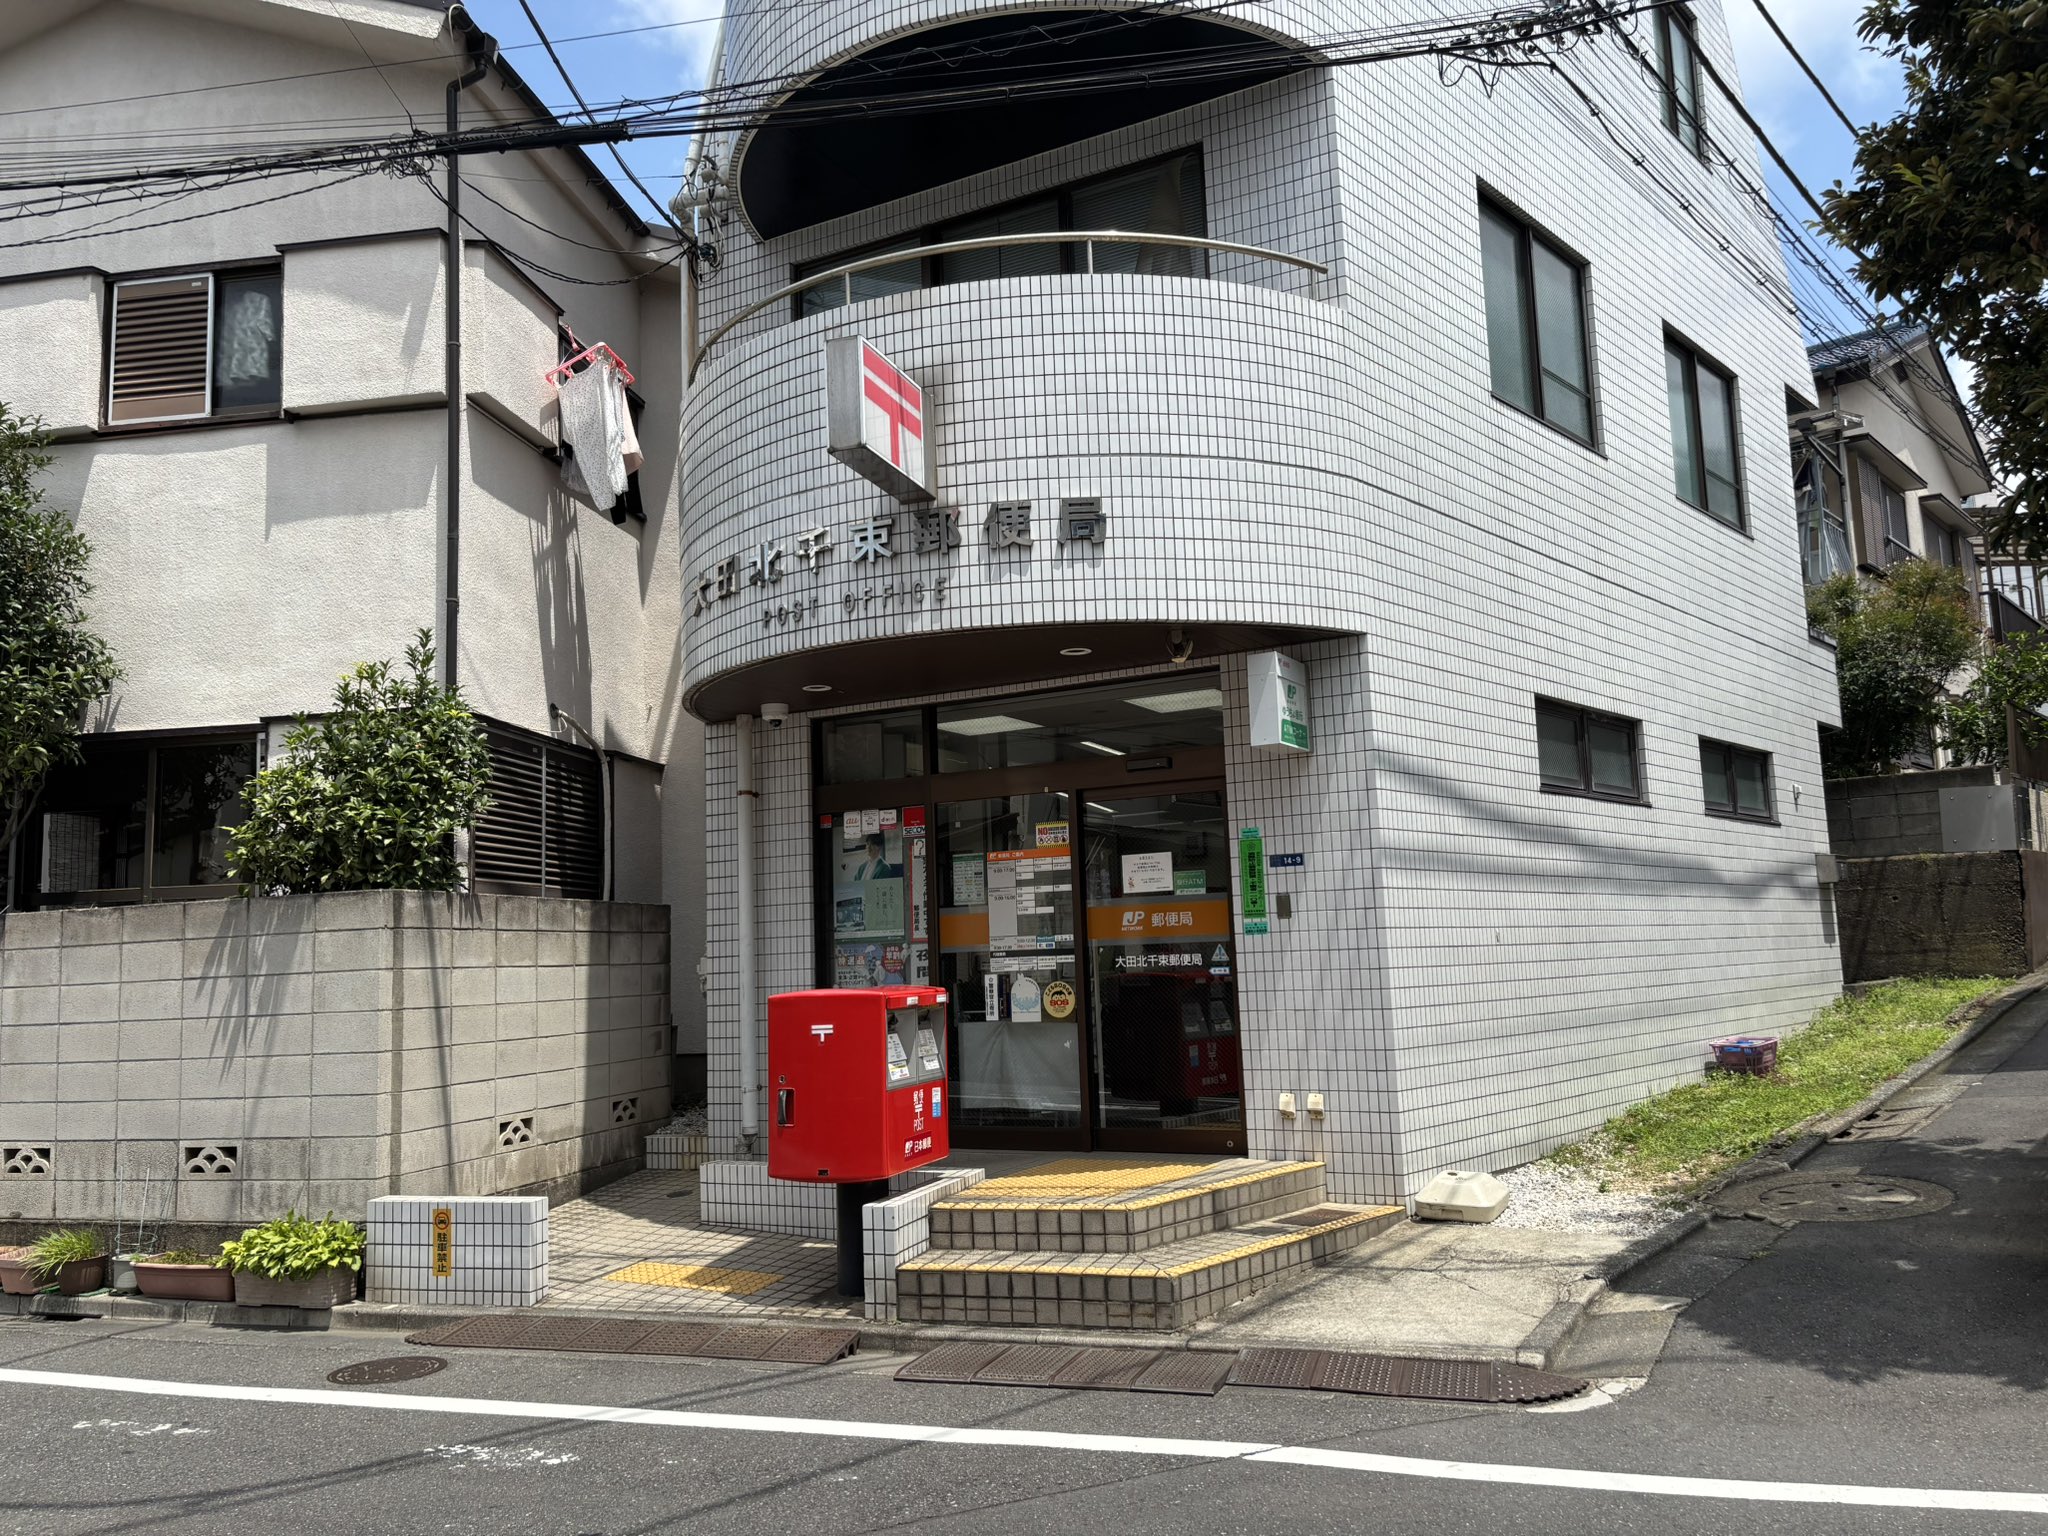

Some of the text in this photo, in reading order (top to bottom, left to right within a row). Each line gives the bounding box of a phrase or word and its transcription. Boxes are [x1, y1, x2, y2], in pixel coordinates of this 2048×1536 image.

[692, 499, 1107, 617] 大田北千束郵便局
[762, 577, 948, 629] POST OFFICE
[1037, 827, 1048, 835] NO
[1151, 911, 1193, 927] 郵便局
[1115, 953, 1203, 968] 大田北千束郵便局
[1049, 999, 1070, 1007] SOS
[913, 1117, 924, 1132] POST
[914, 1136, 932, 1153] 日本郵便
[437, 1232, 448, 1273] 駐車禁止
